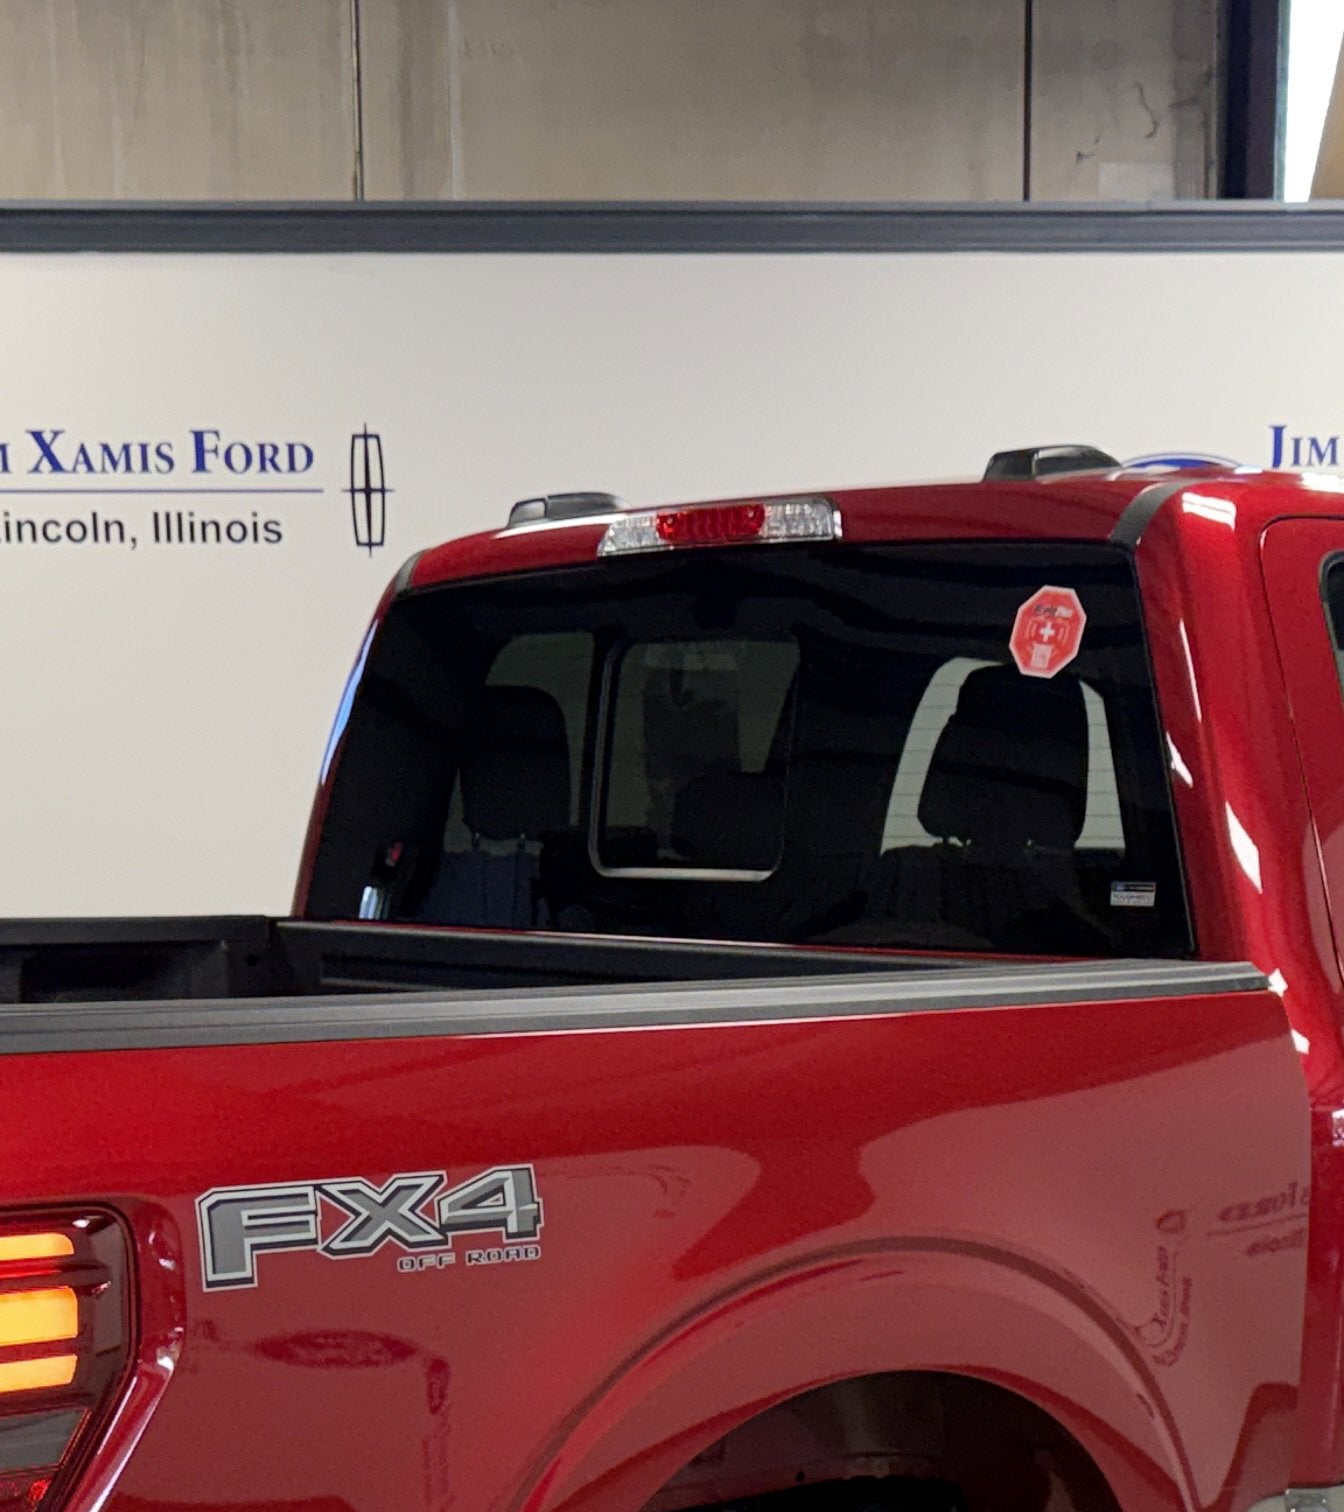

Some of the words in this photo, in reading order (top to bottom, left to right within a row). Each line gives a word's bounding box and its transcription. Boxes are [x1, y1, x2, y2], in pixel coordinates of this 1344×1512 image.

[25, 429, 175, 475] XAMIS
[189, 429, 315, 475] FORD
[1268, 424, 1340, 470] JIM
[153, 511, 284, 545] Illinois
[195, 1163, 544, 1292] FX4
[397, 1253, 457, 1273] OFF
[465, 1245, 542, 1267] ROAD
